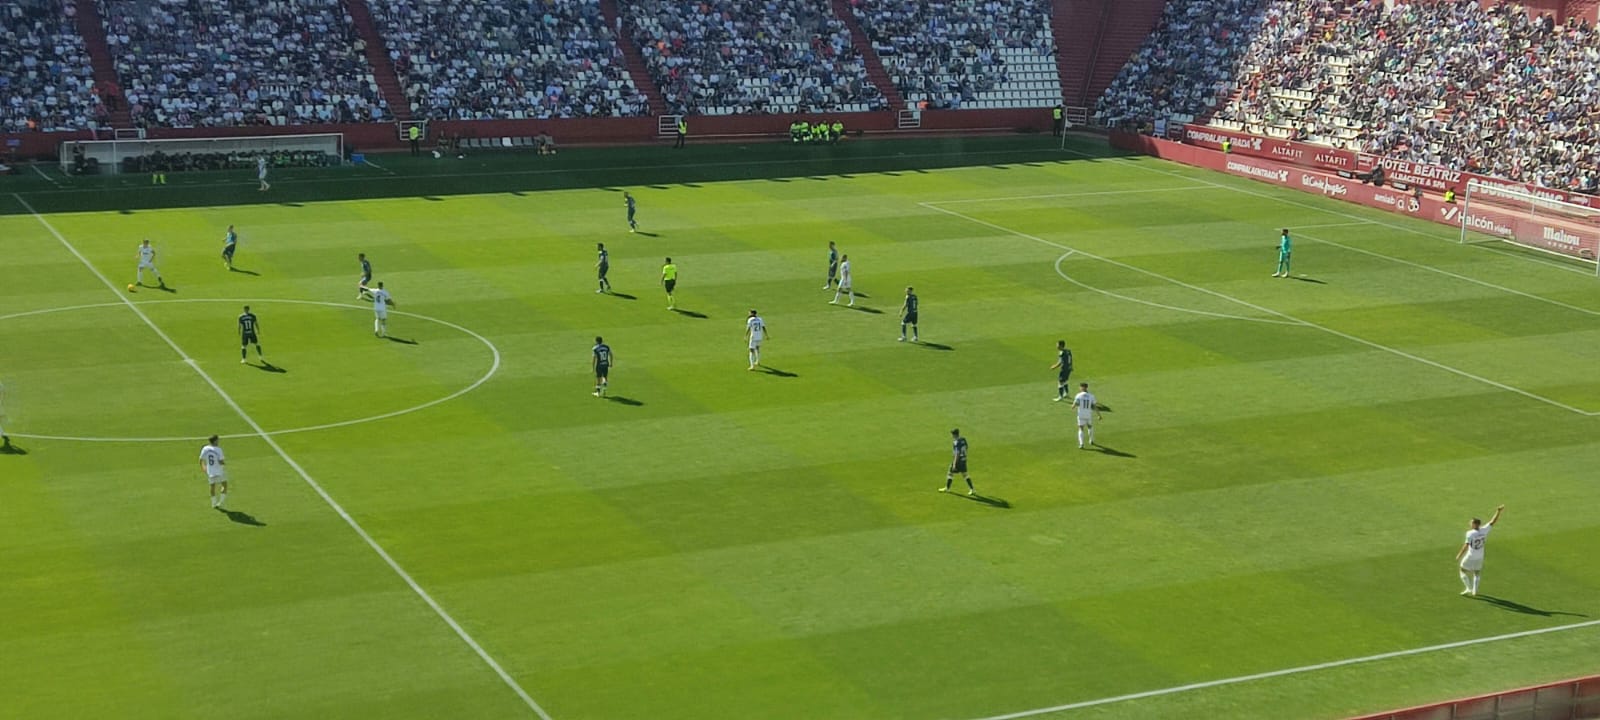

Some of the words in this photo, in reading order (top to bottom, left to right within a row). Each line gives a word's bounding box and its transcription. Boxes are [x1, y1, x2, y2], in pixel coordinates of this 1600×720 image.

[1272, 146, 1303, 158] ALTAFIT
[1315, 153, 1347, 166] ALTAFIT
[1377, 158, 1411, 174] HOTEL
[1414, 165, 1460, 182] BEATRIZ
[1389, 172, 1424, 184] ALBACETE
[1432, 180, 1446, 189] SPA
[1457, 211, 1494, 230] Halcón
[1543, 226, 1580, 246] Mahou
[244, 320, 252, 330] 11
[753, 322, 760, 331] 21
[600, 350, 607, 361] 10
[1082, 399, 1089, 409] 11
[208, 454, 214, 466] 6
